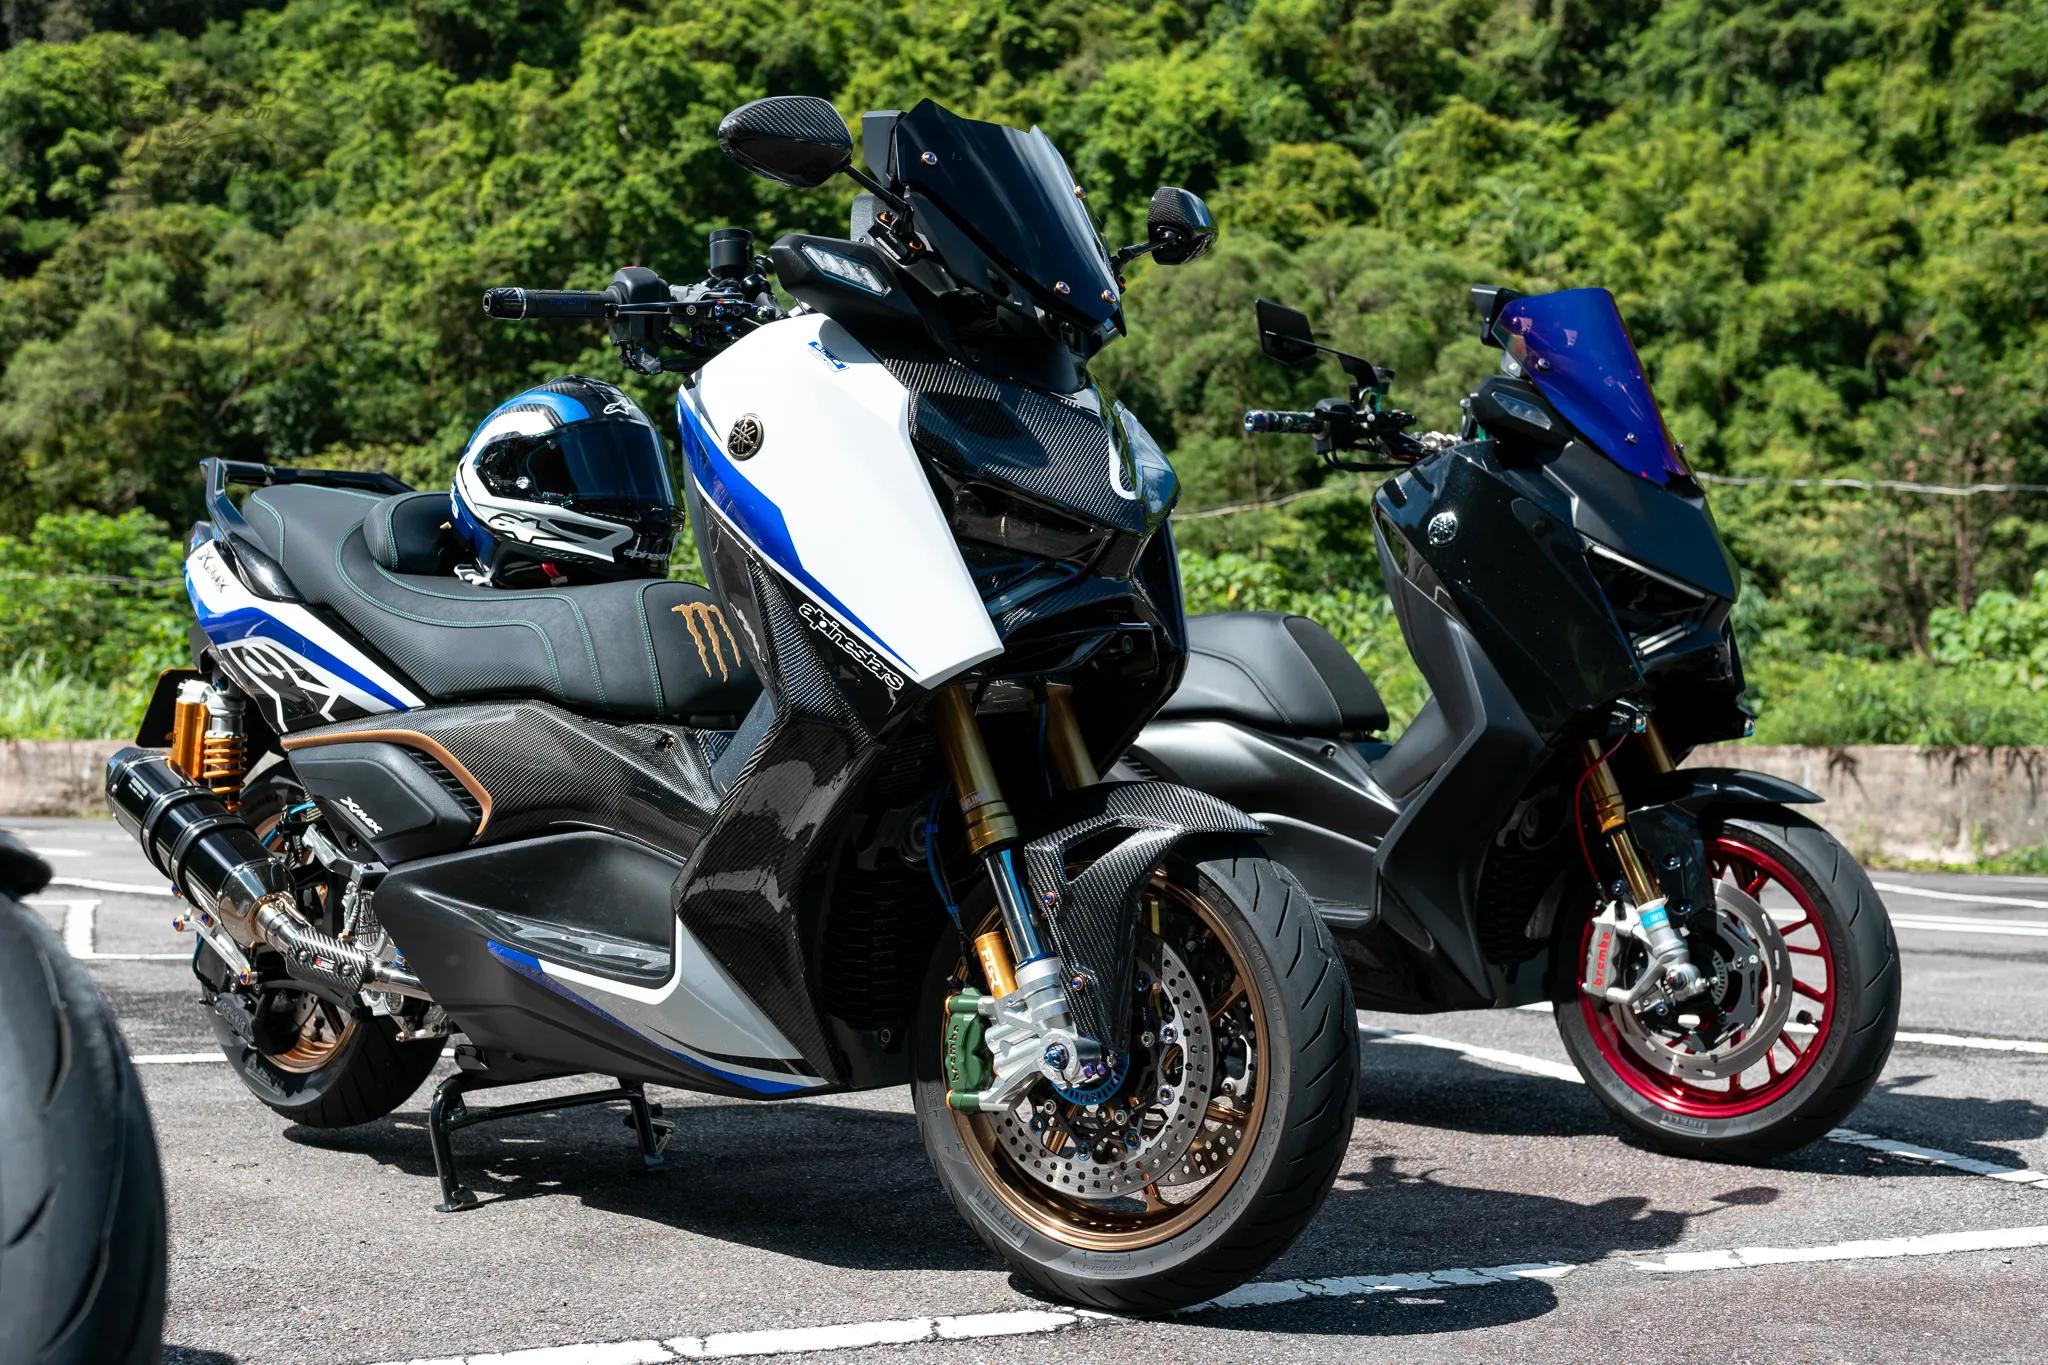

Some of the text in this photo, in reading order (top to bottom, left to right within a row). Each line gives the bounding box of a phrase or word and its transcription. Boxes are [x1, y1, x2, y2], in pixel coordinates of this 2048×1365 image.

[798, 603, 905, 691] alpinestars
[339, 796, 384, 835] XMAX
[980, 948, 998, 992] FGR
[1593, 931, 1611, 987] brembo
[223, 1003, 247, 1034] brembo
[949, 1024, 960, 1083] brembo
[1659, 1112, 1709, 1135] PIRELLI
[967, 1186, 1031, 1249] PIRELLI
